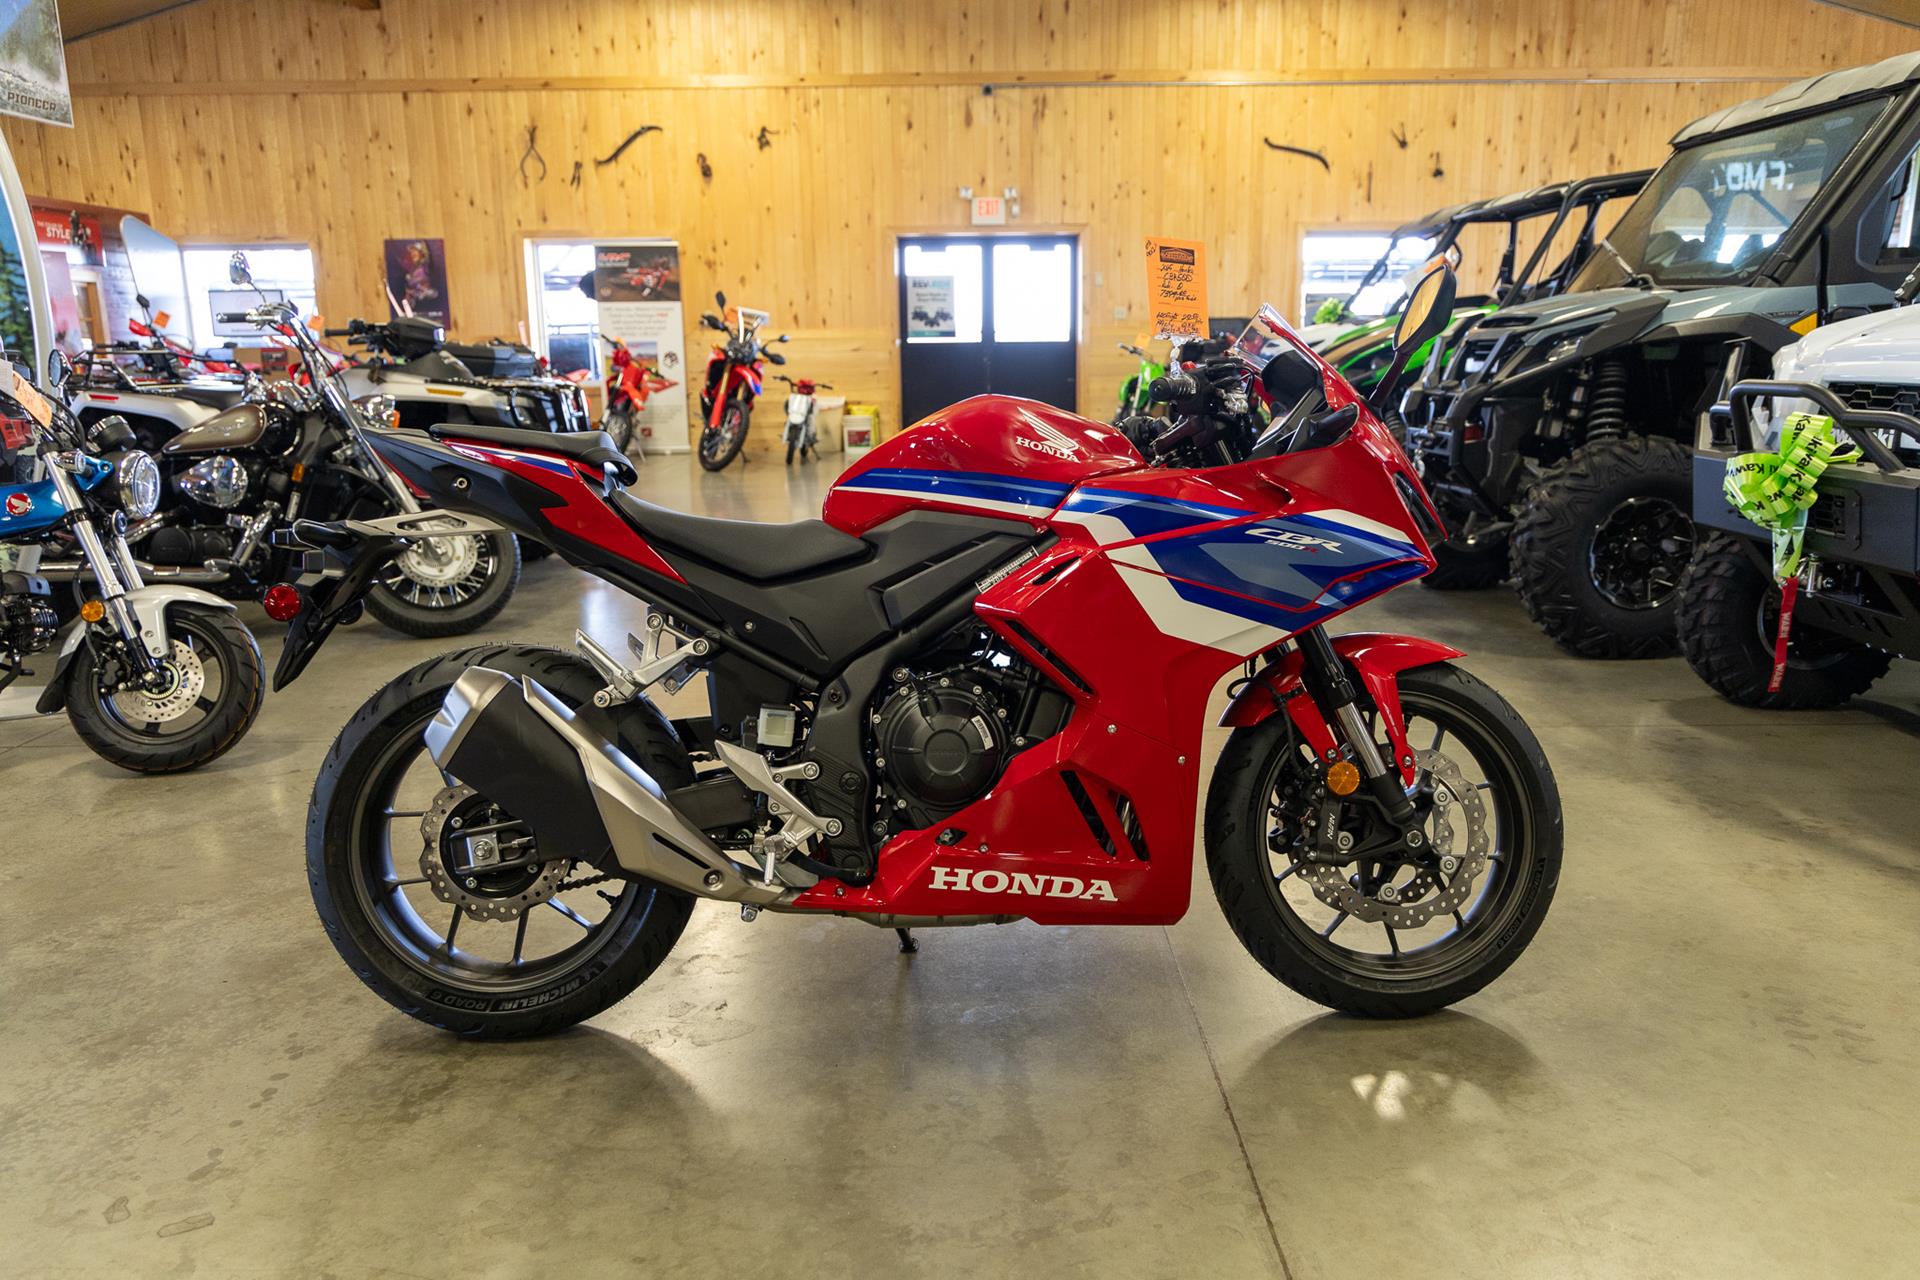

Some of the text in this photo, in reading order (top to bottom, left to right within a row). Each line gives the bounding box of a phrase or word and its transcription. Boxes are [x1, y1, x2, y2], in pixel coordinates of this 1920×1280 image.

[8, 92, 57, 111] PIONEER
[977, 199, 1000, 216] EXIT
[46, 226, 71, 239] STYLE
[1016, 436, 1081, 464] HONDA
[1245, 528, 1344, 554] CBR
[1264, 540, 1318, 553] 500R
[928, 866, 1119, 902] HONDA
[443, 995, 486, 1010] ROAD
[500, 979, 580, 1011] MICHELIN
